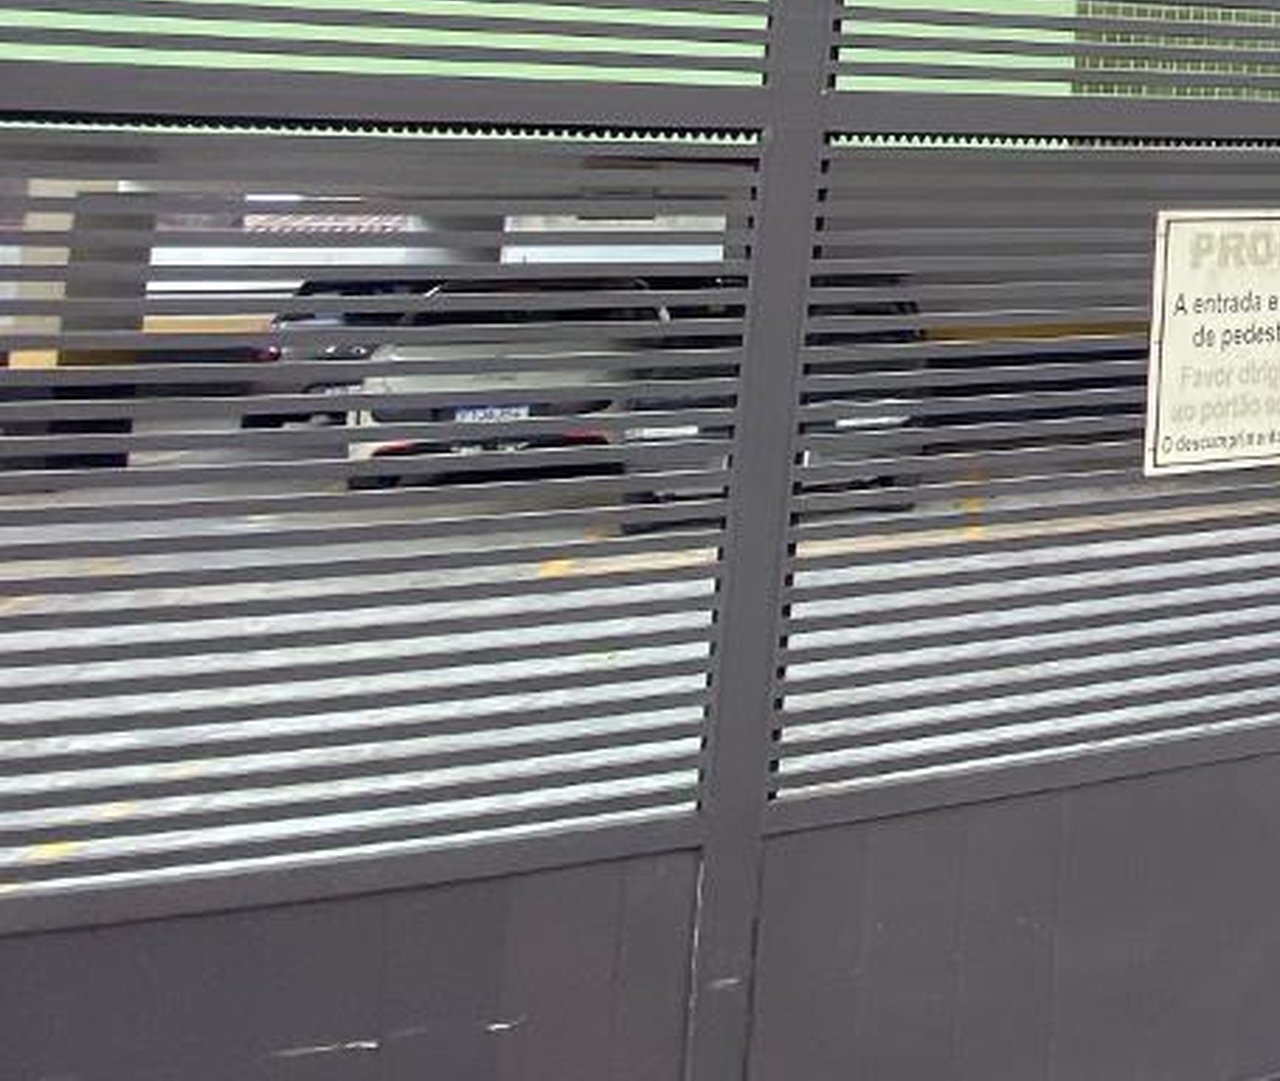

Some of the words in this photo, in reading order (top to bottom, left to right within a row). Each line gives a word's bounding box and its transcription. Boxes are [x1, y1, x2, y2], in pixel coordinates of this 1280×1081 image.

[1173, 296, 1188, 316] A
[1193, 290, 1262, 314] entrada
[1268, 296, 1279, 312] e
[1192, 326, 1217, 348] de
[1180, 364, 1231, 388] Favor
[1172, 403, 1195, 423] ao
[1200, 395, 1260, 425] portão
[1161, 435, 1174, 454] O
